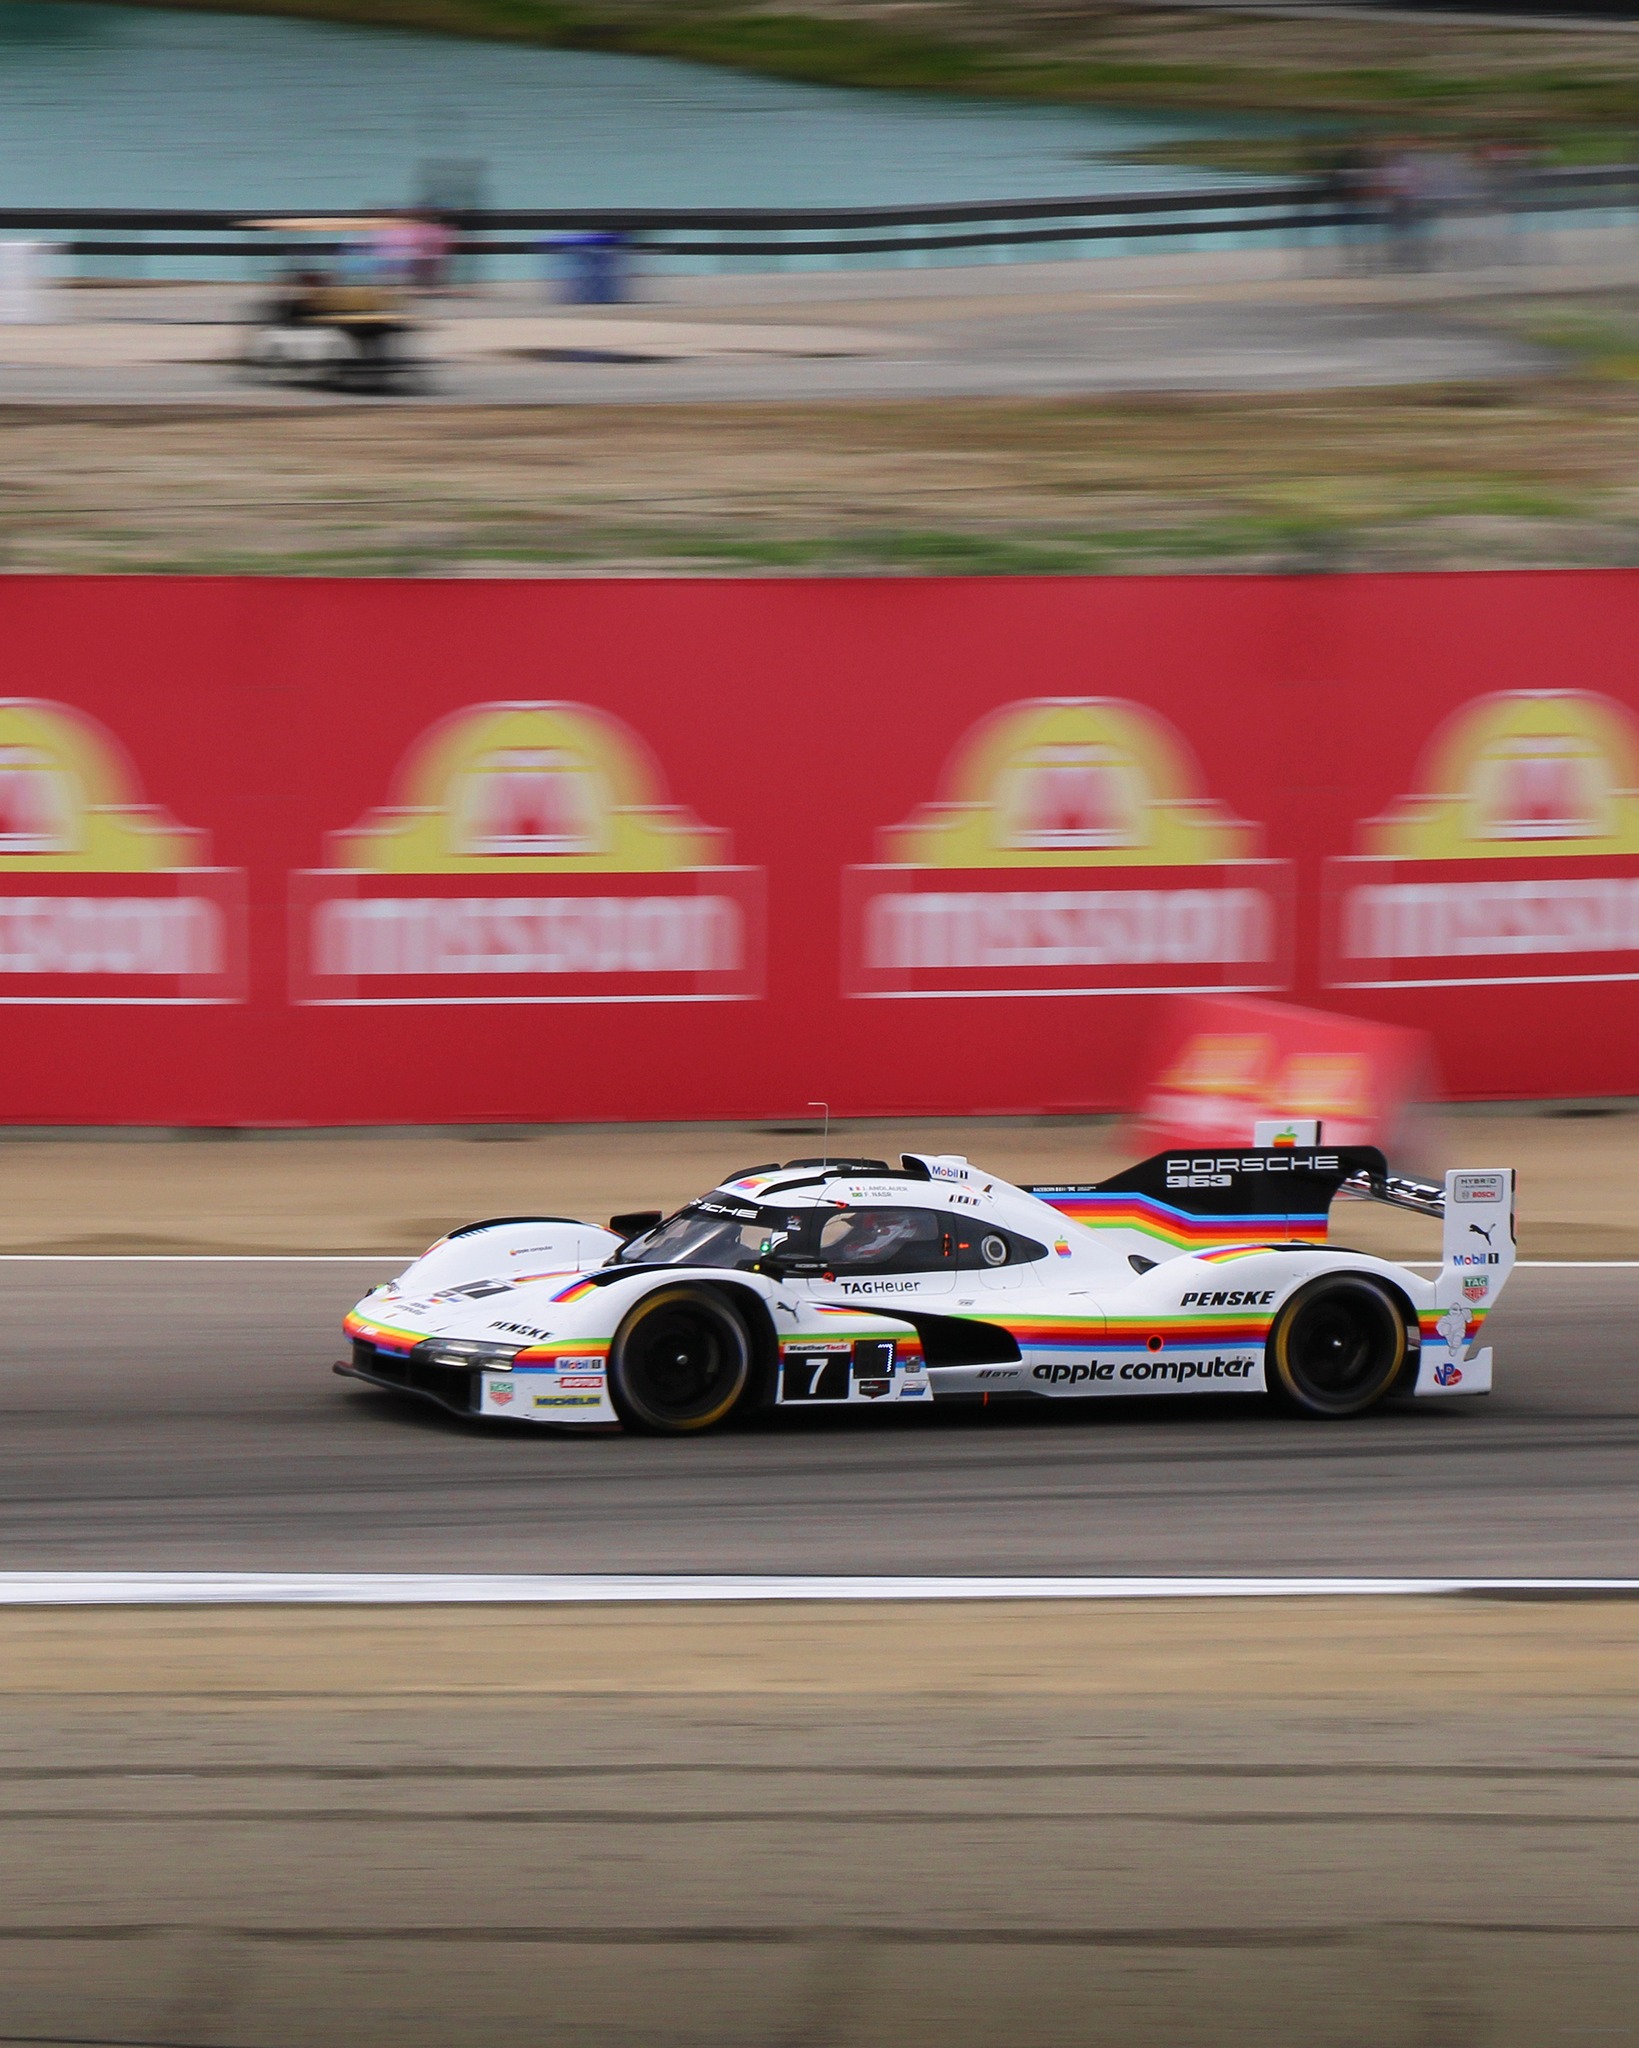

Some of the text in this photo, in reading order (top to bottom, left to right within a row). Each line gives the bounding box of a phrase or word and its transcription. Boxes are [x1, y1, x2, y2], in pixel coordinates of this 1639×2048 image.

[1167, 1155, 1339, 1174] PORSCHE
[932, 1166, 958, 1179] Mobil
[1166, 1174, 1232, 1188] 963
[1453, 1254, 1486, 1265] Mobil
[1466, 1278, 1486, 1286] TAG
[1180, 1290, 1275, 1307] PENSKE
[487, 1321, 555, 1340] PENSKE
[560, 1359, 588, 1369] Mobil
[877, 1343, 894, 1373] 7
[805, 1358, 829, 1394] 7
[1032, 1356, 1255, 1384] apple computer
[537, 1397, 600, 1406] MICHELIN
